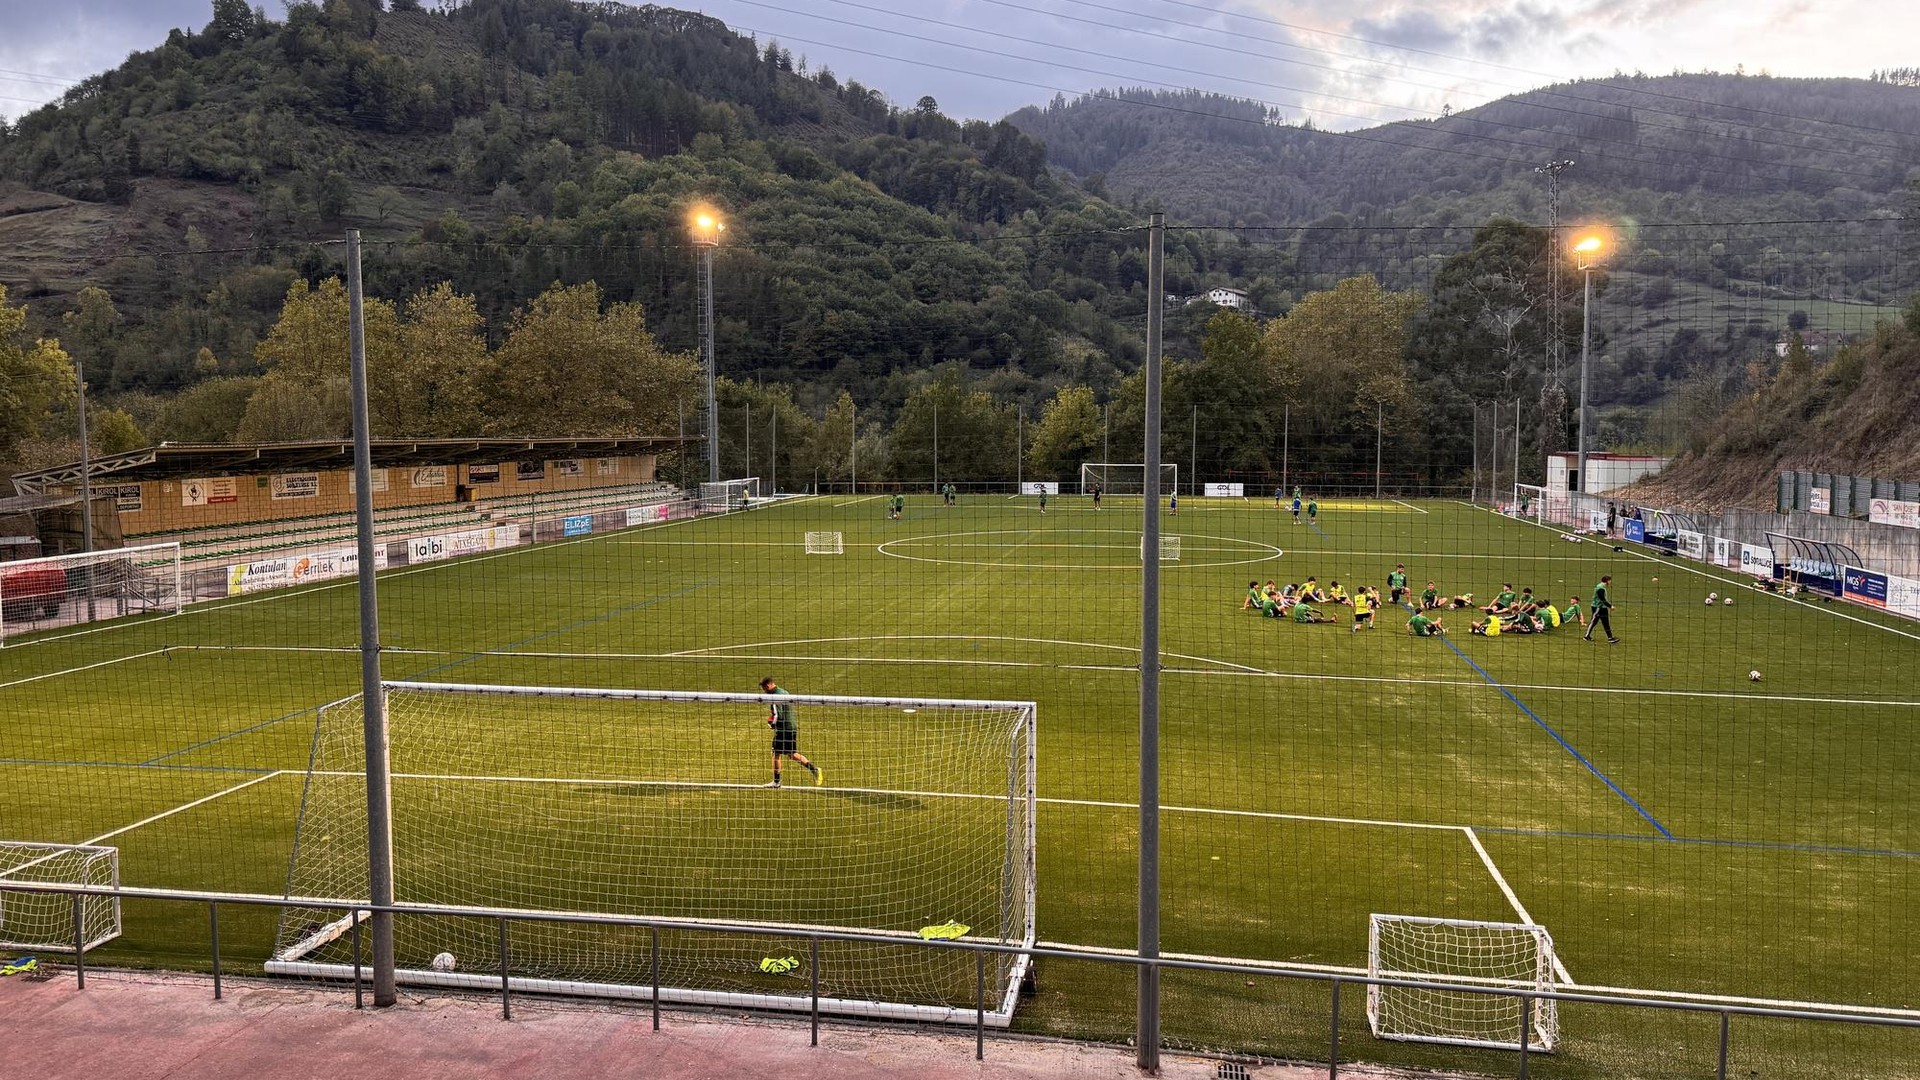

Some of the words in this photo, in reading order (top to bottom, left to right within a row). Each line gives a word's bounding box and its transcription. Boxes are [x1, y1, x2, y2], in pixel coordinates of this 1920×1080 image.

[98, 487, 118, 495] KIROL
[120, 486, 140, 494] KIROL
[415, 538, 442, 557] laibi
[248, 560, 286, 576] Kontulan
